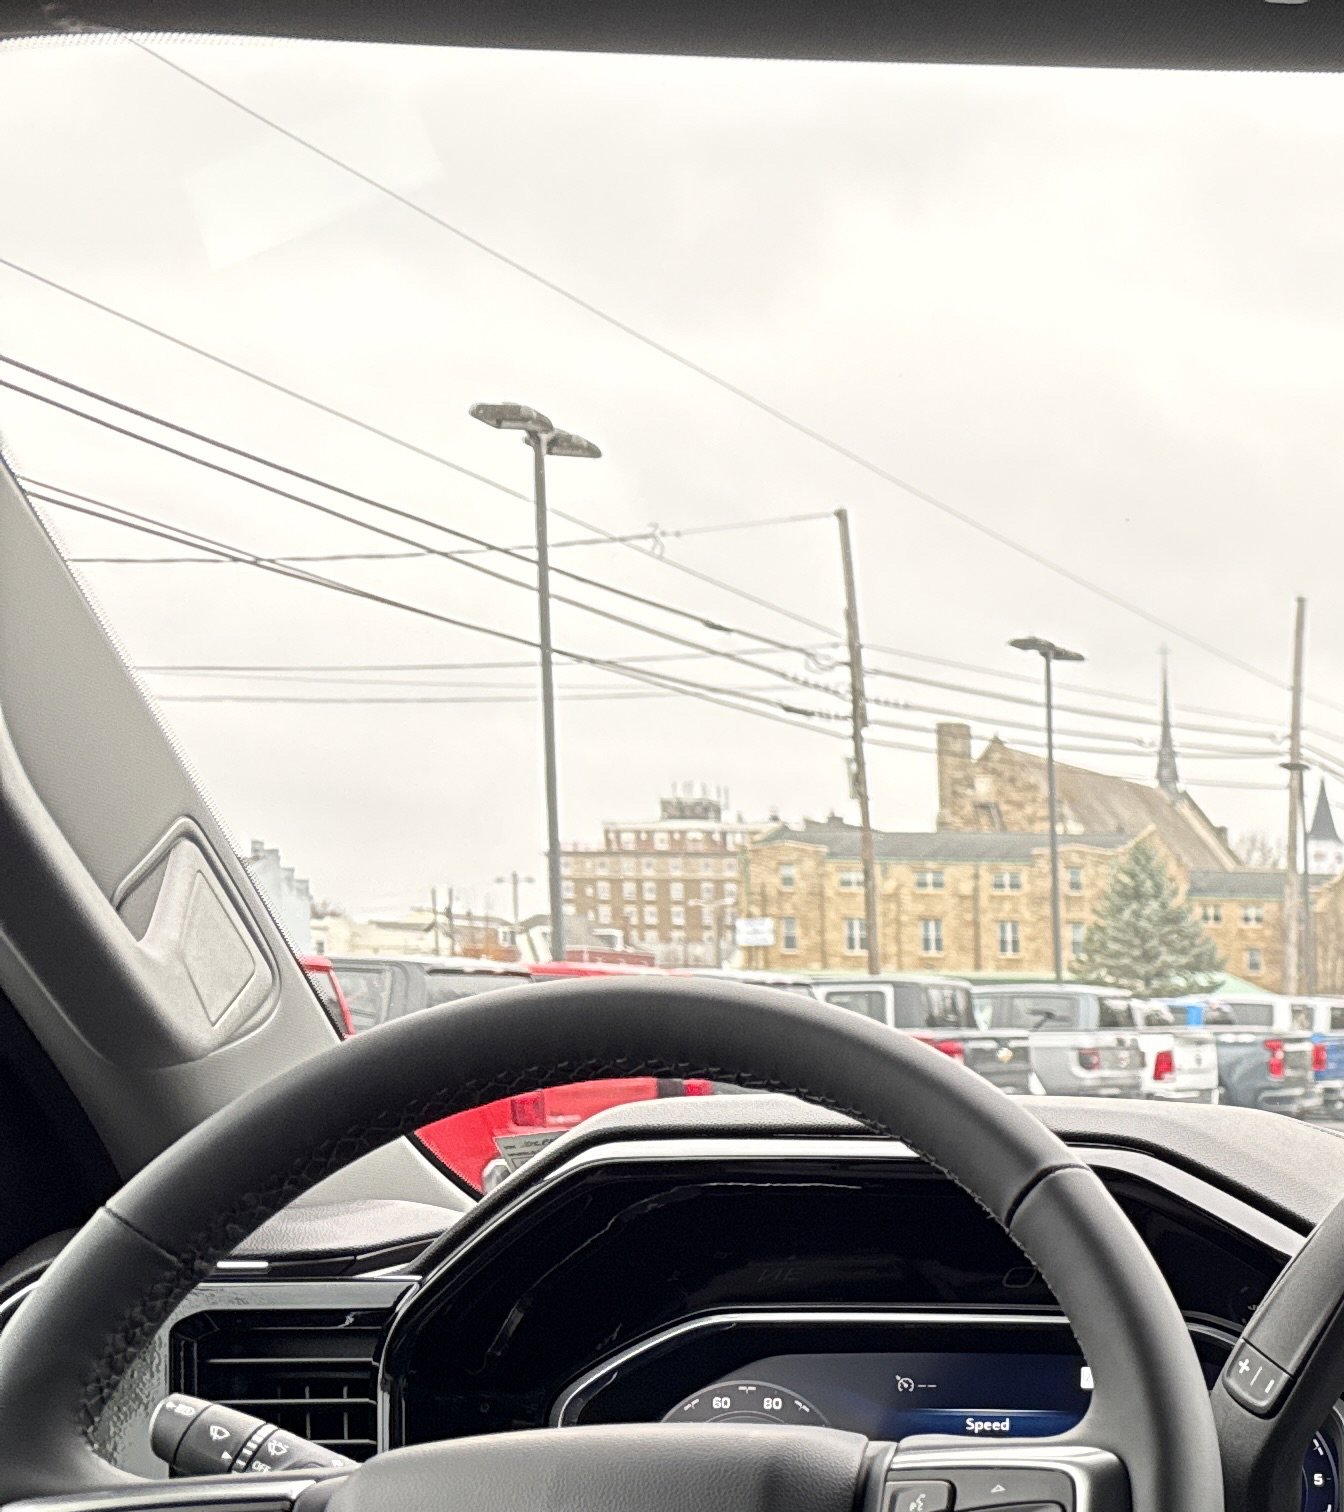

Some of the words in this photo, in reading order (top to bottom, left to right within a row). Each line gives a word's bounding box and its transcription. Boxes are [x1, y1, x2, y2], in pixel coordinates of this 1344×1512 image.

[711, 1396, 731, 1410] 60
[763, 1396, 783, 1411] 80
[965, 1417, 1010, 1434] Speed
[1313, 1473, 1323, 1486] 5
